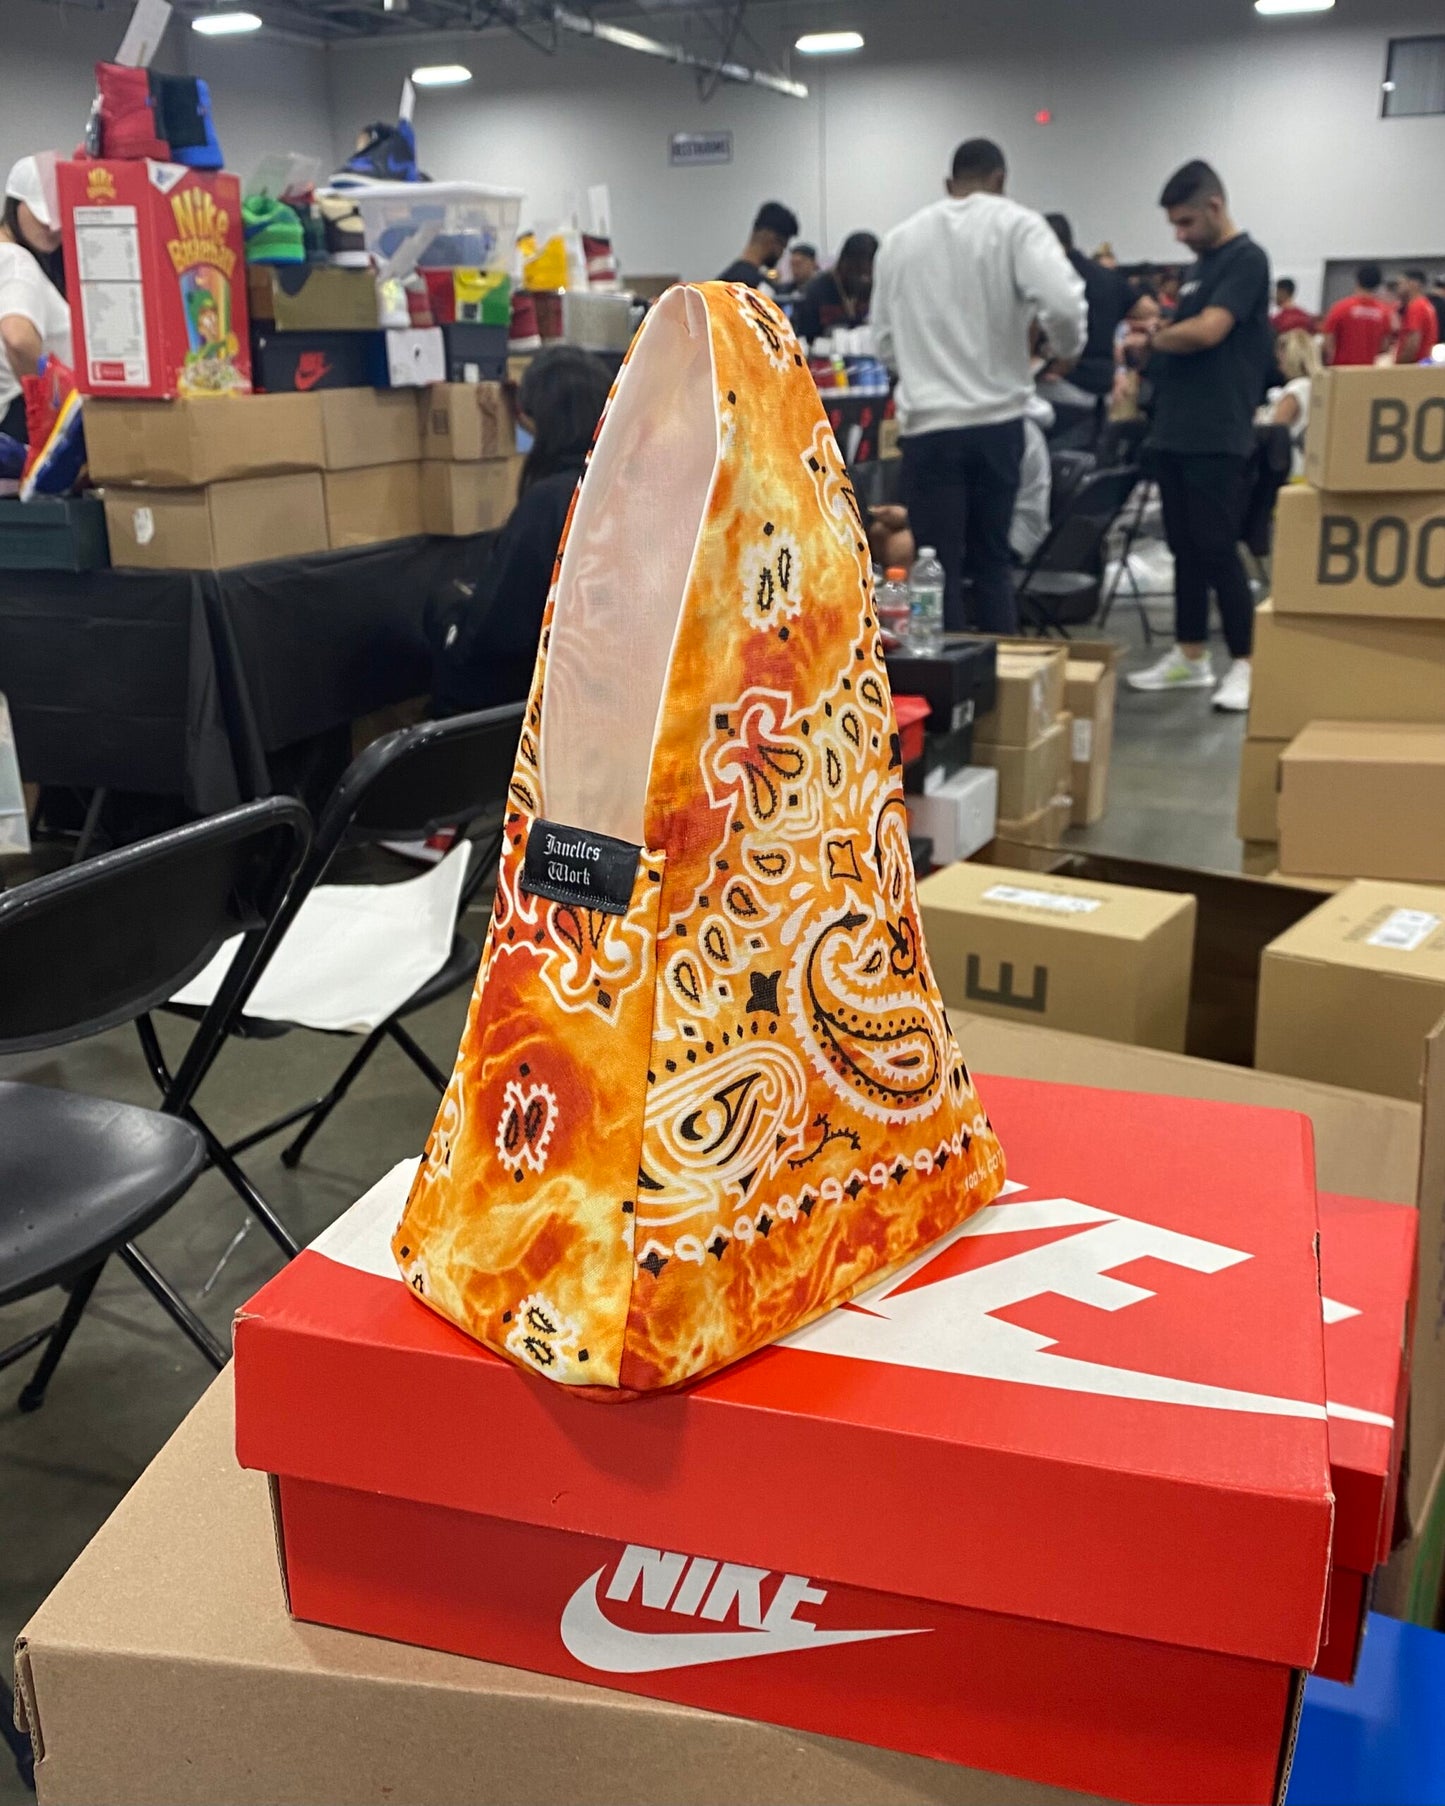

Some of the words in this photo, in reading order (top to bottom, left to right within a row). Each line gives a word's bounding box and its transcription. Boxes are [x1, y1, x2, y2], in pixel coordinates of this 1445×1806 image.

[543, 833, 602, 861] Janelles
[548, 860, 591, 886] Work
[605, 1544, 829, 1632] NIKE
